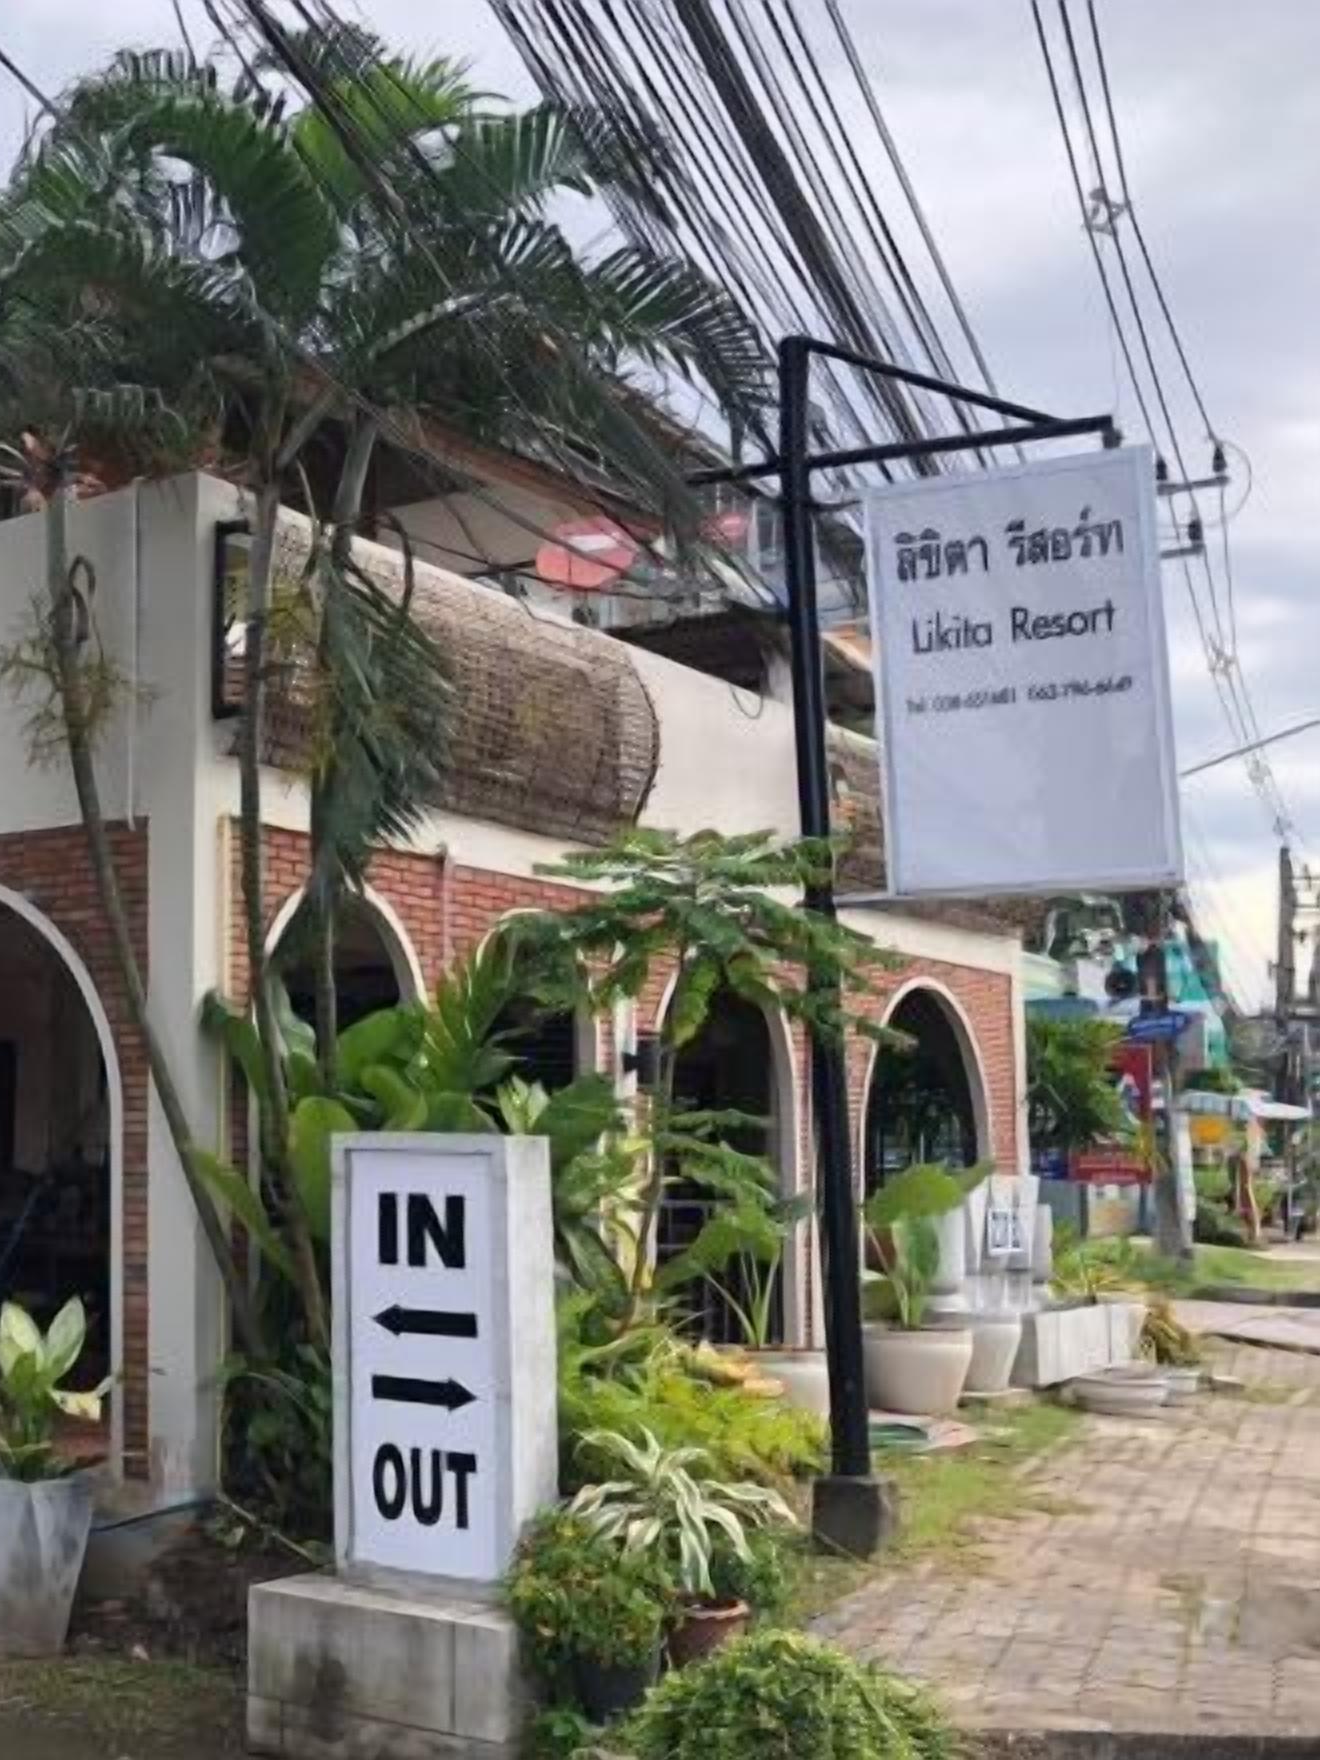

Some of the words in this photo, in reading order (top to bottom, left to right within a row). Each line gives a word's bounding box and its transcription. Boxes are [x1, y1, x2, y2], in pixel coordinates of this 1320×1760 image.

[893, 527, 989, 583] ลิขิตา
[1004, 504, 1125, 567] รีสอร์ท
[912, 610, 993, 655] Likita
[1010, 598, 1116, 643] Resort
[377, 1191, 466, 1270] IN
[371, 1441, 478, 1530] OUT
